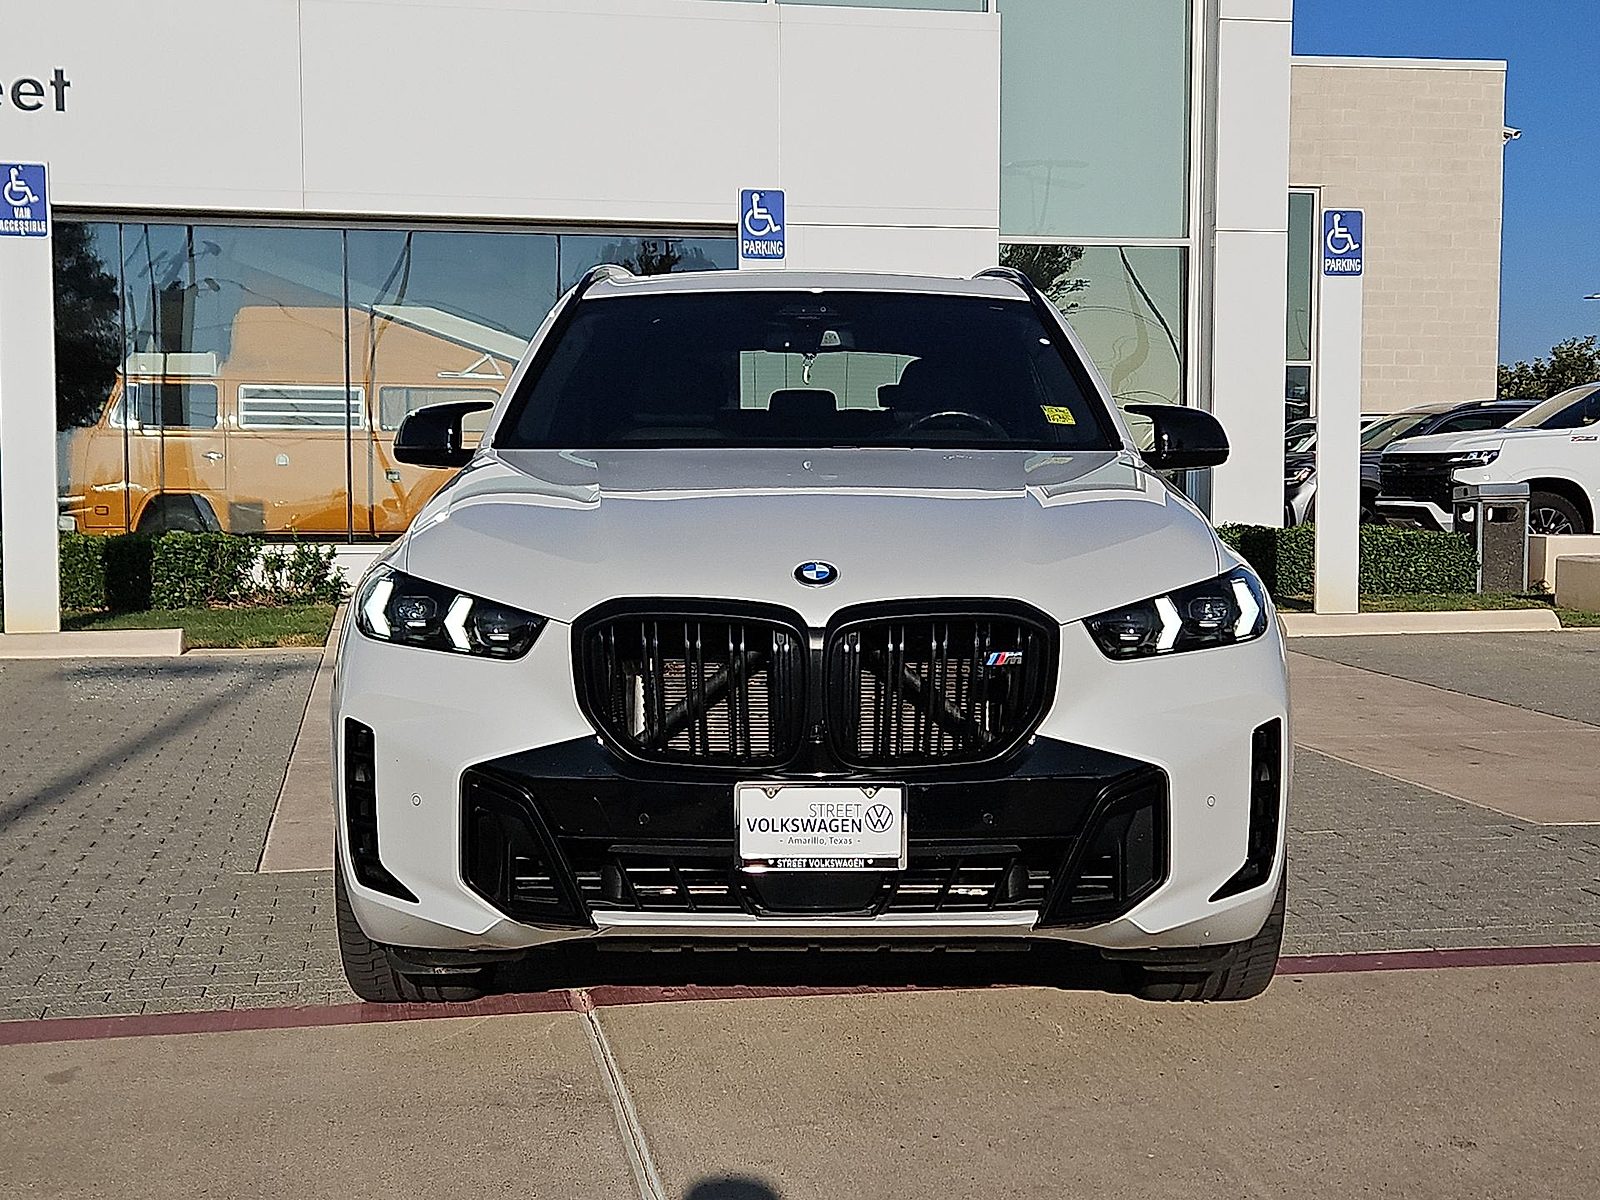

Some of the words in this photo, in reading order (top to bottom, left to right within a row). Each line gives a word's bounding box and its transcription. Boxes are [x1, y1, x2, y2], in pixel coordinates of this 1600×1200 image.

[0, 69, 71, 112] et
[743, 240, 784, 255] PARKING
[1325, 258, 1361, 272] PARKING
[809, 803, 862, 818] STREET
[746, 818, 862, 833] VOLKSWAGEN
[787, 836, 828, 846] Amarillo,
[829, 836, 853, 845] Texas
[776, 858, 807, 868] STREET
[809, 858, 865, 868] VOLKSWAGEN
